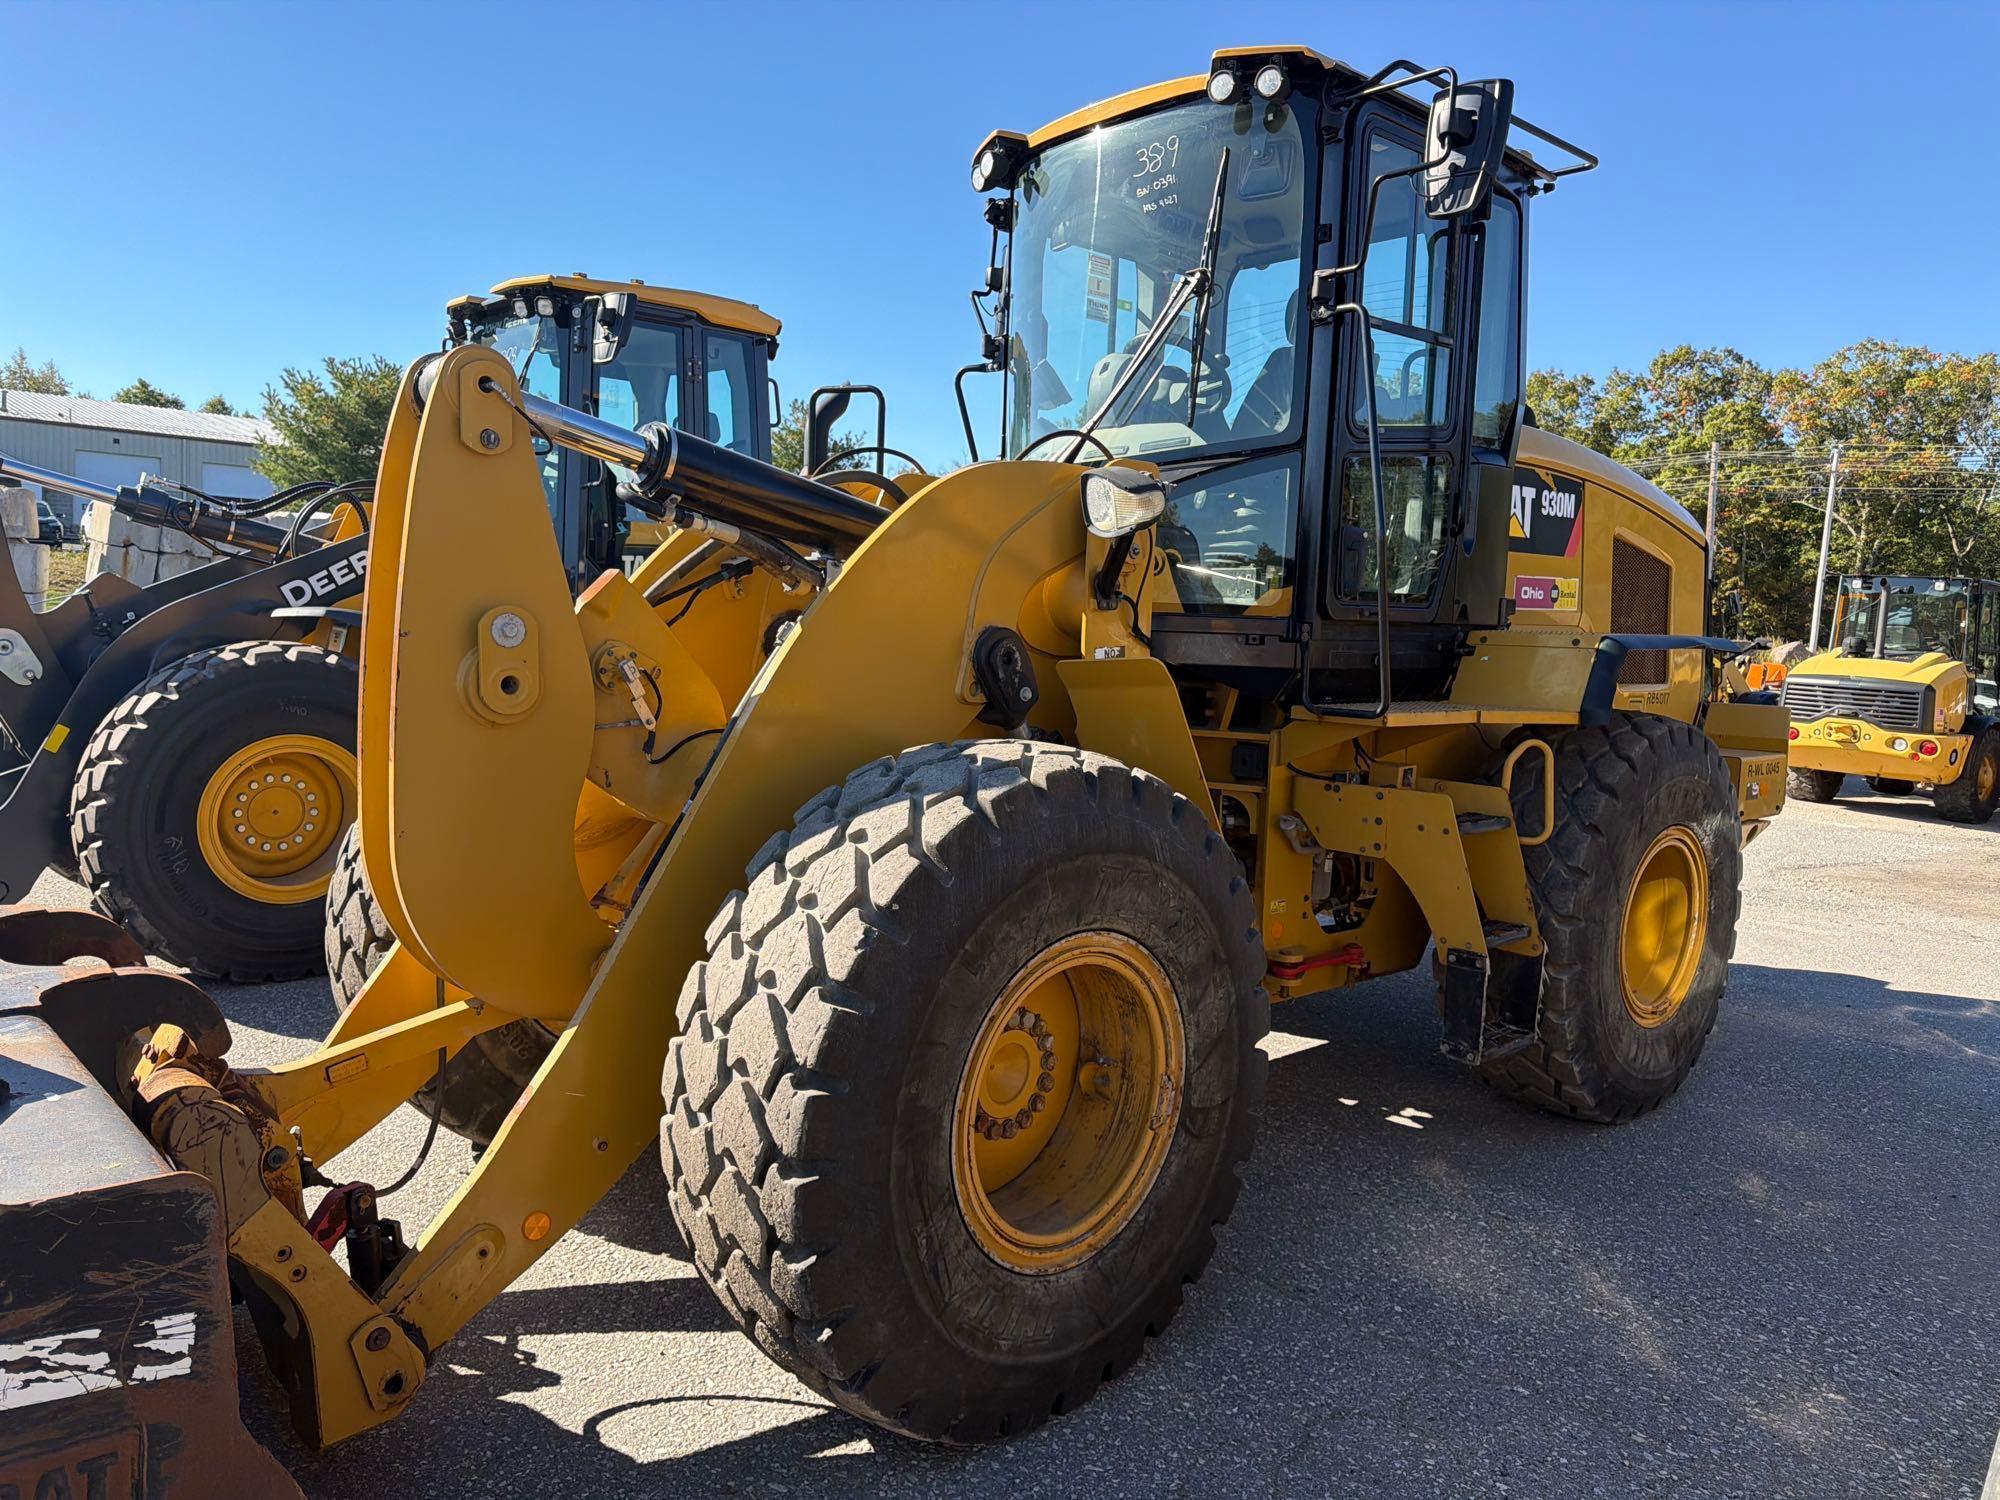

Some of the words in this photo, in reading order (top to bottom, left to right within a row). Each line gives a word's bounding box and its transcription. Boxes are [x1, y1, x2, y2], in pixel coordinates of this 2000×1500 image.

[1132, 135, 1179, 178] 389
[1541, 489, 1576, 519] 930M
[1521, 586, 1545, 600] Ohio
[1560, 590, 1577, 599] Rental
[1765, 761, 1780, 776] 0045
